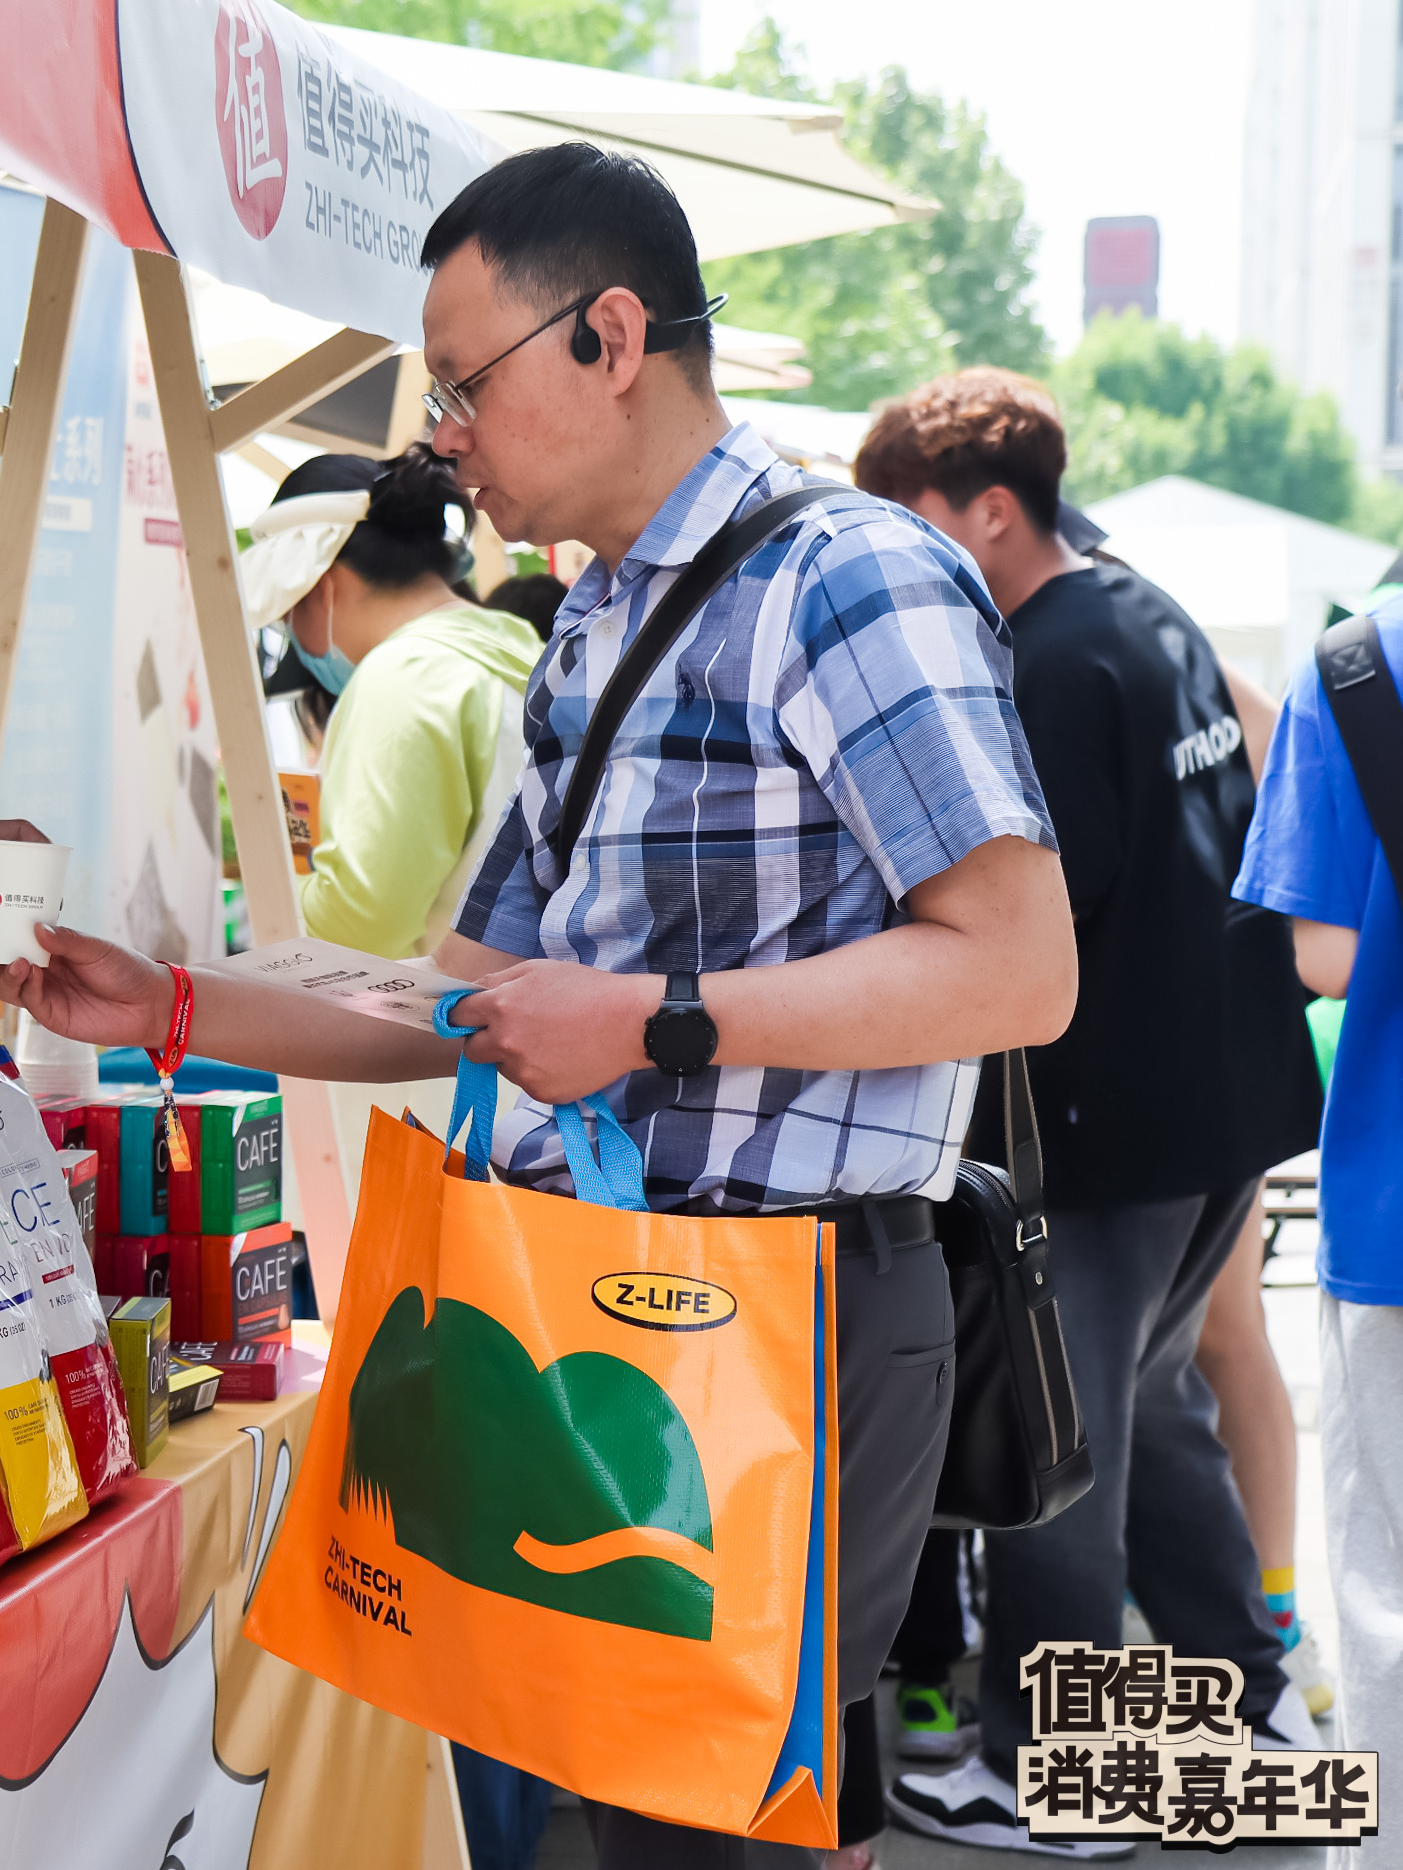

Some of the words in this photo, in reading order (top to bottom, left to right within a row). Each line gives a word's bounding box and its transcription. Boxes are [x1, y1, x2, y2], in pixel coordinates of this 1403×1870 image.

[297, 46, 434, 211] 值得买科技
[304, 180, 383, 260] ZHI-TECH
[178, 998, 190, 1045] CARNIVAL
[55, 1294, 66, 1306] KG
[614, 1282, 711, 1315] Z-LIFE
[65, 1369, 86, 1383] 100%
[326, 1535, 403, 1603] ZHI-TECH
[323, 1570, 413, 1637] CARNIVAL
